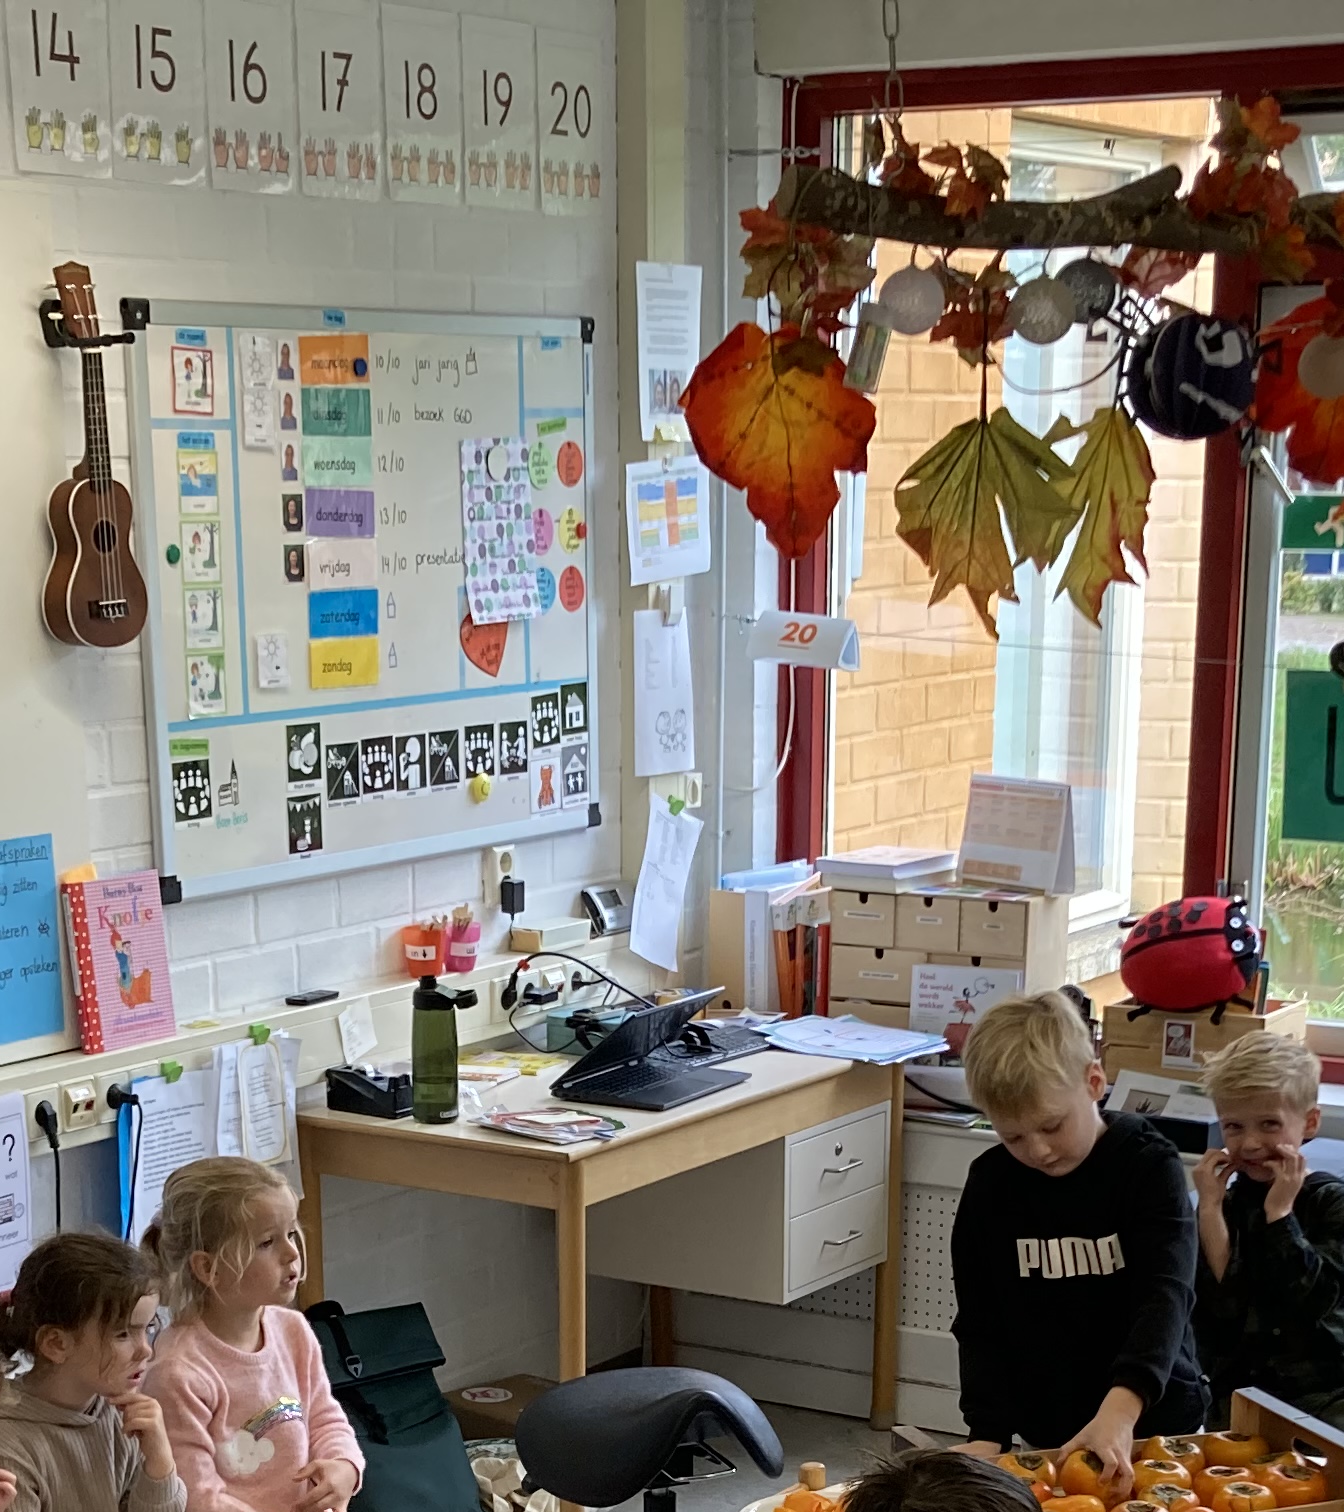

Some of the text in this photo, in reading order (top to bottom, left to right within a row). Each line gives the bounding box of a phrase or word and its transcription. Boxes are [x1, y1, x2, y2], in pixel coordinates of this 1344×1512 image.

[31, 8, 81, 81] 14
[135, 24, 176, 92] 15
[228, 39, 267, 104] 16
[321, 50, 353, 112] 17
[404, 60, 437, 120] 18
[483, 69, 513, 127] 19
[550, 81, 592, 139] 20
[375, 348, 401, 374] 10/10
[377, 402, 472, 426] 11/10 bezoek GGD
[314, 457, 356, 474] woensdag
[378, 451, 404, 473] 12/10
[316, 509, 363, 527] donderdag
[379, 502, 406, 527] 13/10
[319, 558, 350, 577] vrijdag
[381, 552, 406, 576] 14/10
[320, 609, 360, 627] zaterdag
[779, 621, 818, 644] 20
[322, 658, 352, 675] zondag
[13, 877, 38, 894] zitten
[20, 955, 58, 983] opsteken
[930, 984, 953, 992] wereld
[918, 1002, 944, 1010] wakker
[1016, 1232, 1125, 1279] PUMA
